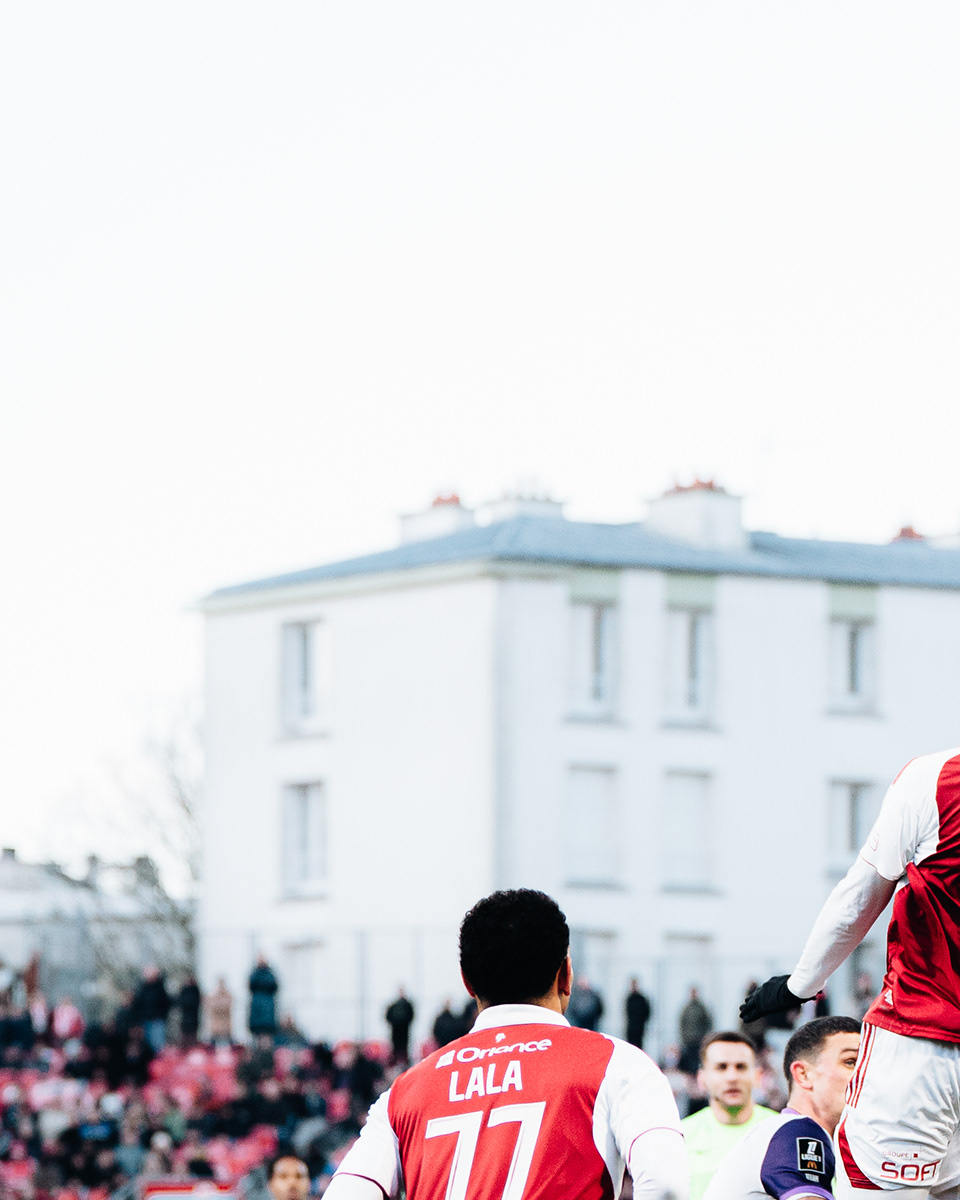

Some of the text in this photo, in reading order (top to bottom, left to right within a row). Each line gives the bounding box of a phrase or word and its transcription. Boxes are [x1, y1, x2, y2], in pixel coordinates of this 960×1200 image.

[456, 1038, 552, 1063] Oriance
[448, 1060, 523, 1102] LALA
[880, 1159, 942, 1181] SOFT
